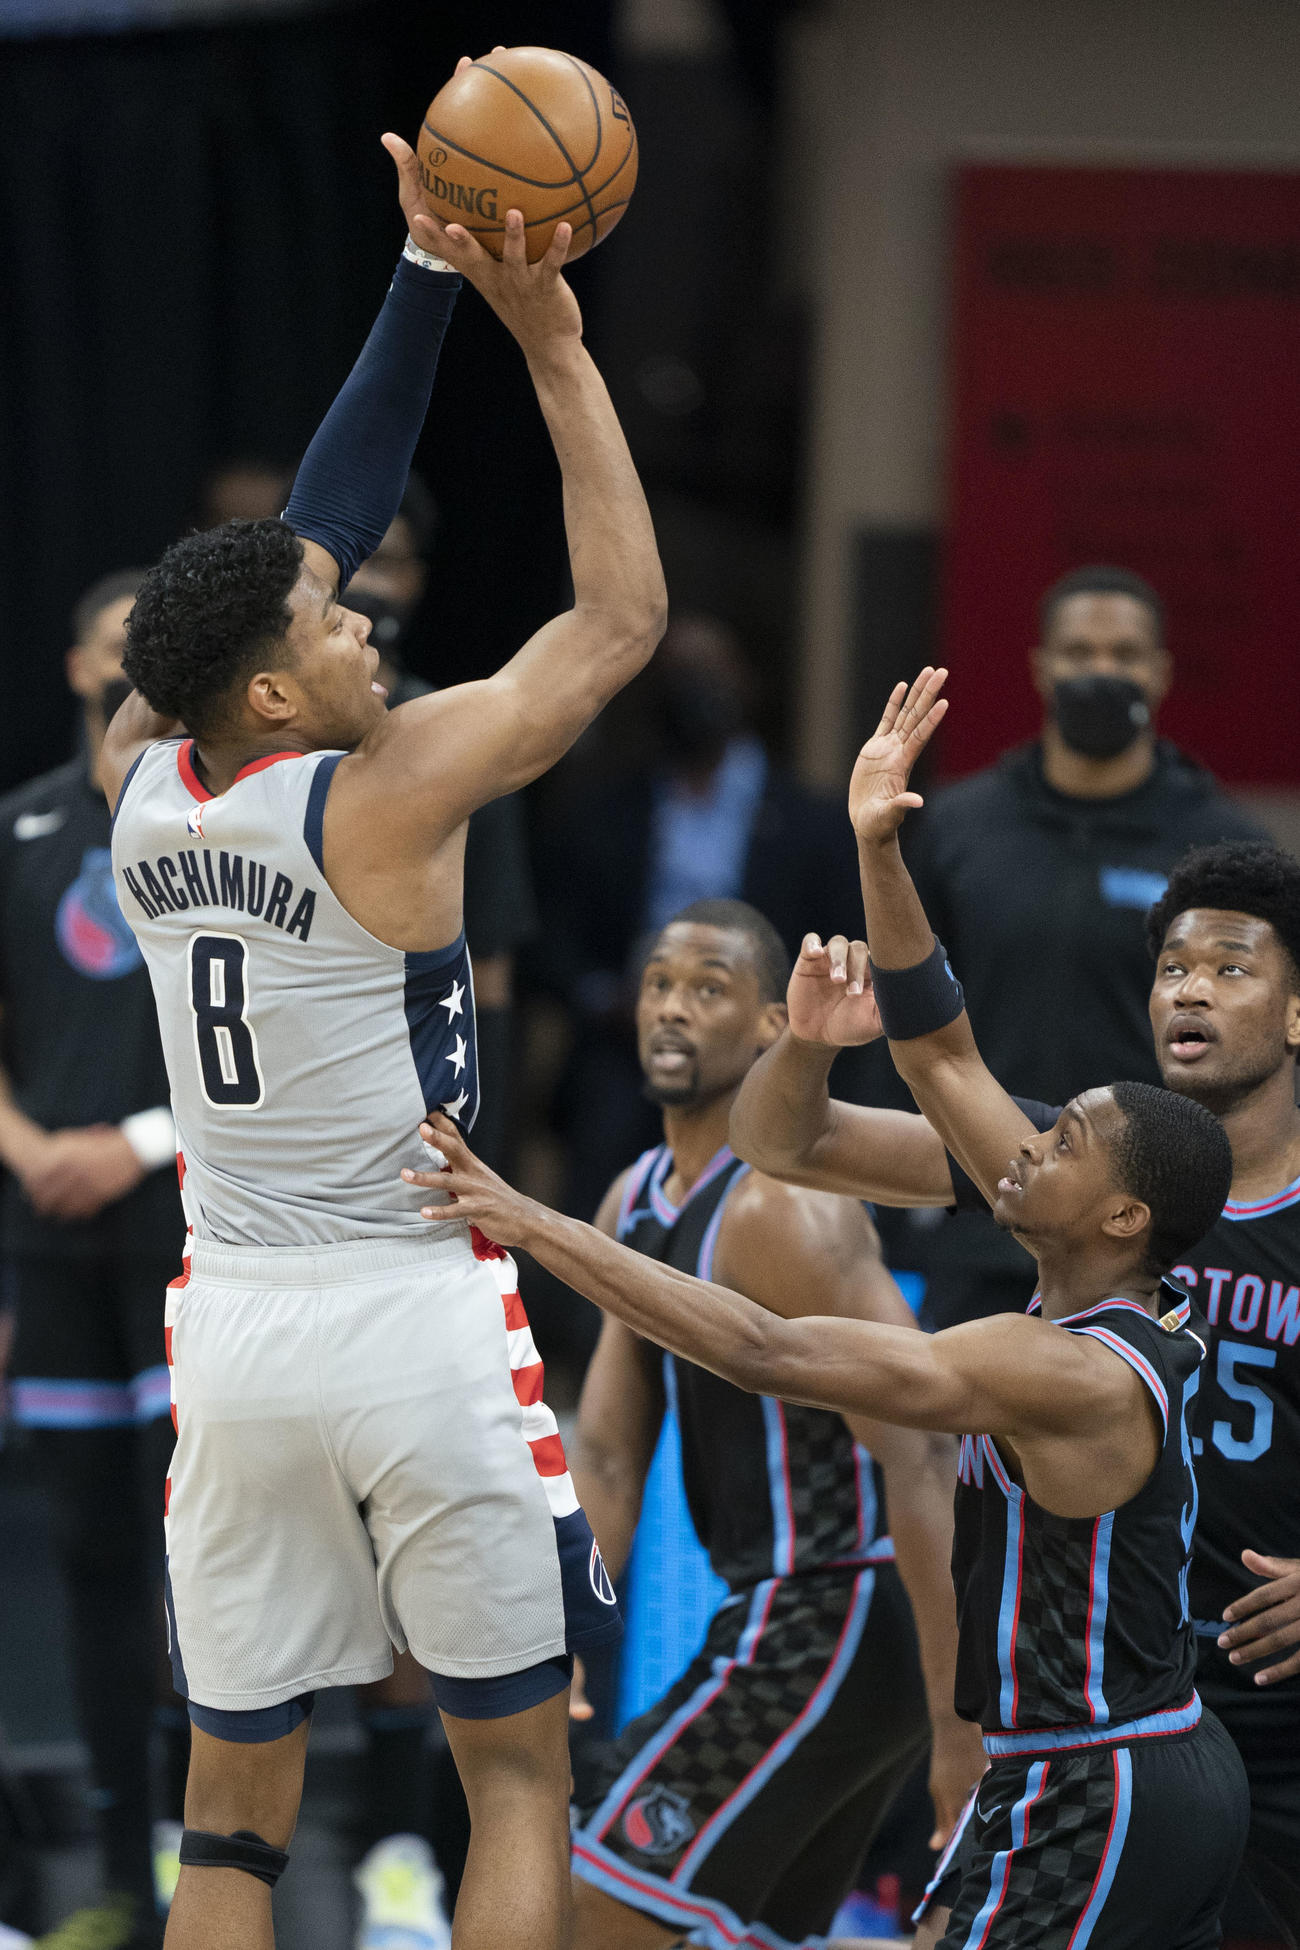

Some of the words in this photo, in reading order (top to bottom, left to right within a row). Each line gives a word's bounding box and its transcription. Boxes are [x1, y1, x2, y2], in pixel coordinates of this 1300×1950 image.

[123, 849, 317, 942] HACHIMURA
[187, 930, 265, 1110] 8
[1192, 1339, 1277, 1462] 5
